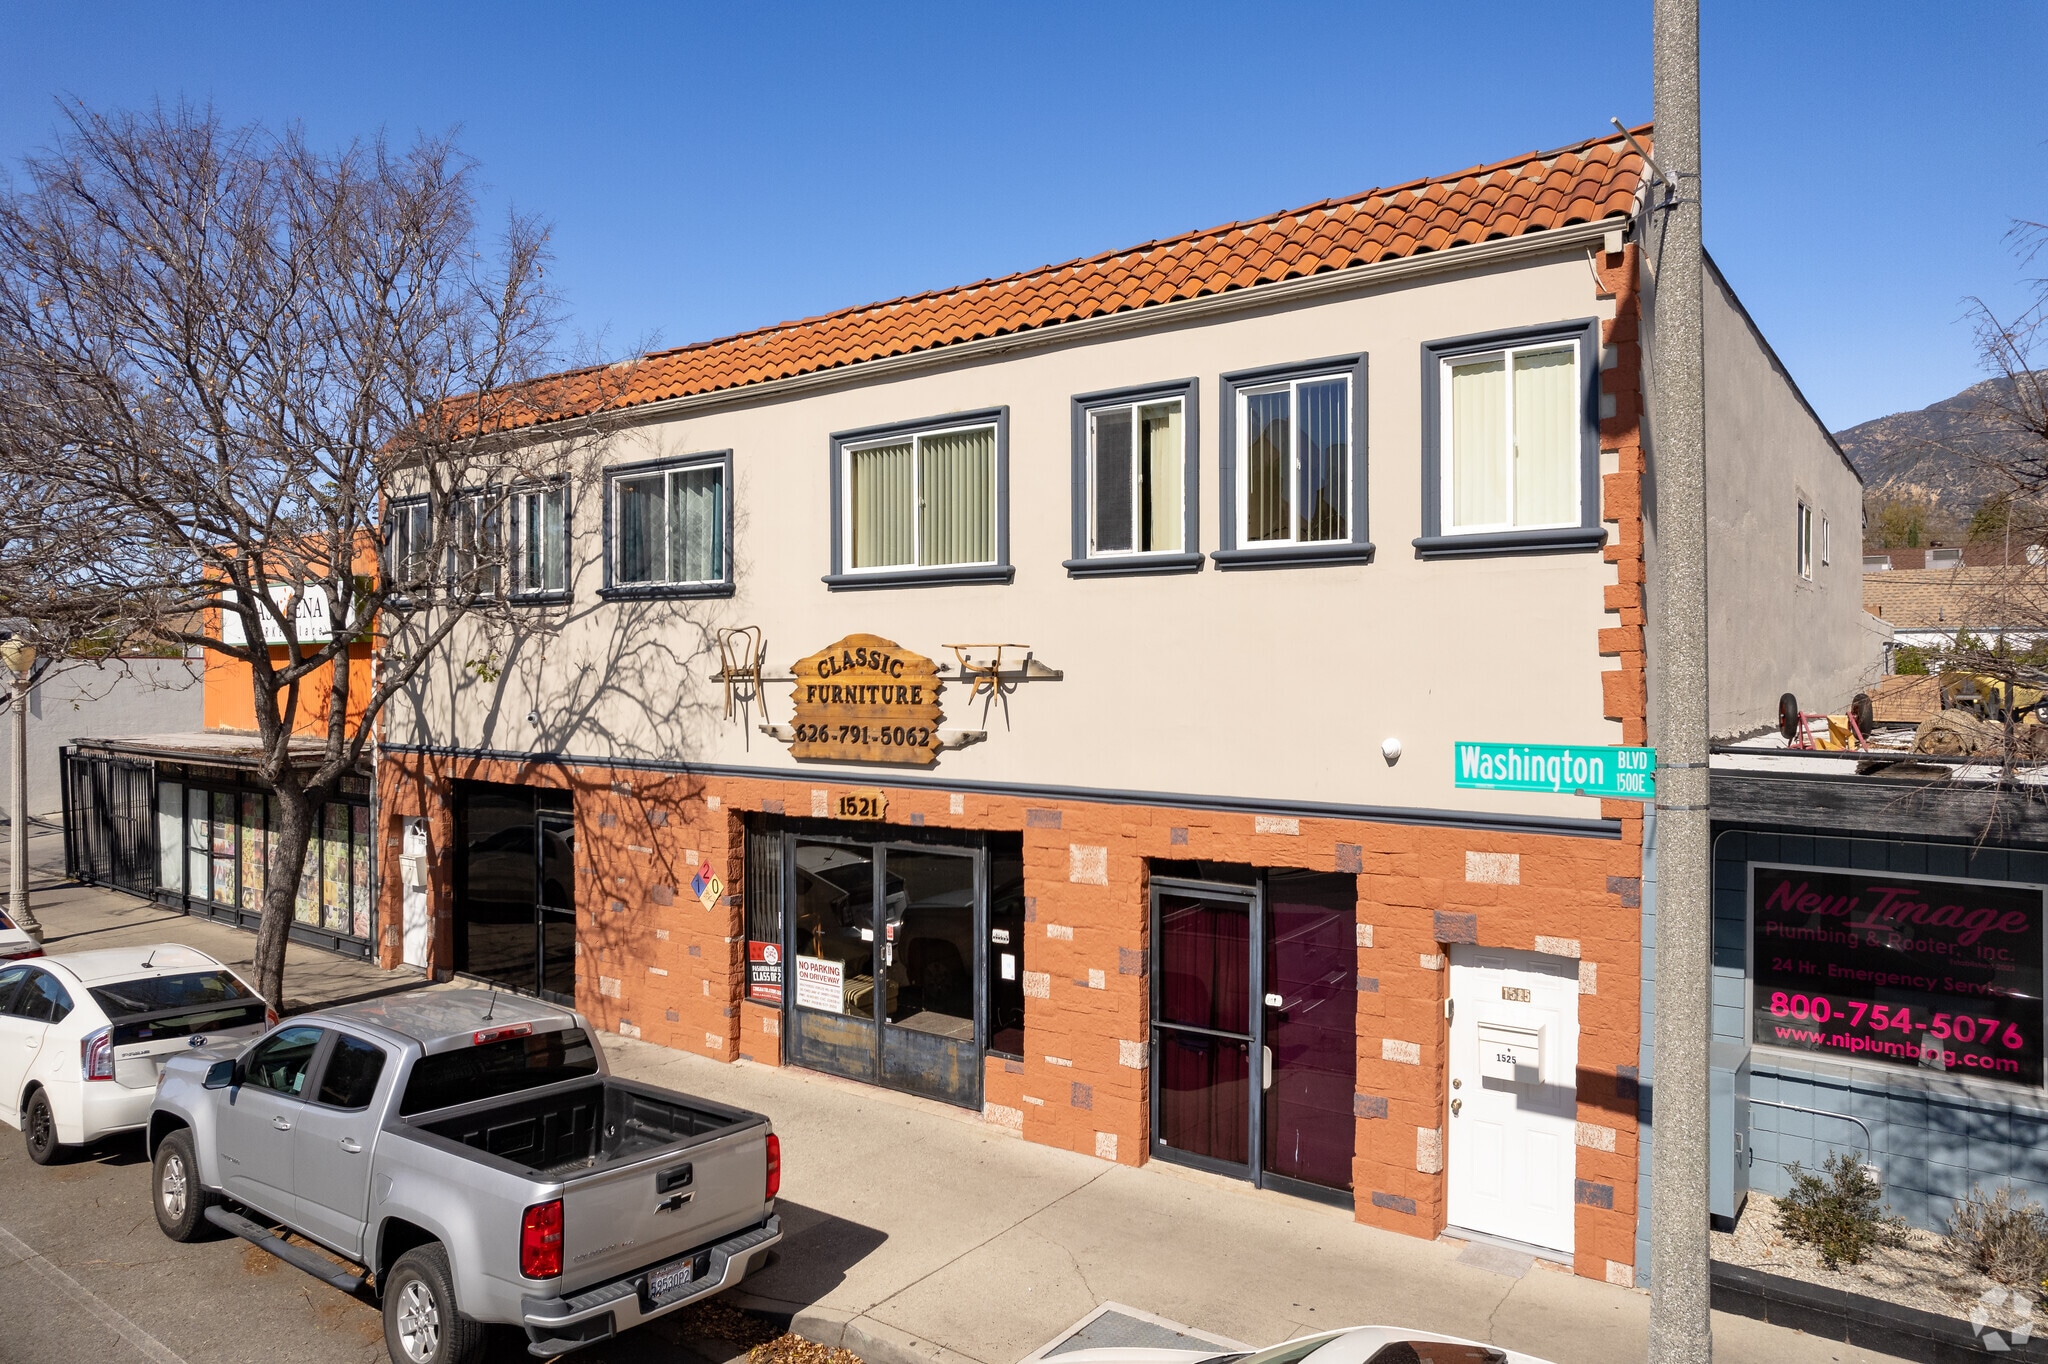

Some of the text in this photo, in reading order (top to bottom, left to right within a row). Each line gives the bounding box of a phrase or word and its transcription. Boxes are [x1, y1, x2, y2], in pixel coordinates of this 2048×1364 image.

[817, 647, 905, 679] CLASSIC
[806, 684, 923, 705] FURNITURE
[796, 723, 930, 747] 626-791-5062
[1460, 745, 1648, 792] Washington BLVD
[1616, 772, 1646, 792] 1500E
[839, 796, 878, 817] 1521
[702, 863, 710, 880] 2
[1764, 879, 2030, 946] New Image
[1765, 920, 1859, 949] Plumbing
[1865, 931, 1881, 948] &
[1976, 942, 2016, 962] inc.
[753, 971, 770, 982] CLASS
[798, 960, 840, 977] NO PARKING
[799, 971, 840, 984] ON DRIVEWAY
[1771, 957, 2020, 999] 24 Hr. Emergency Service
[1770, 991, 2024, 1049] 800-754-5076
[1496, 1053, 1517, 1065] 1525
[1774, 1025, 2020, 1073] www.niplumbing.com
